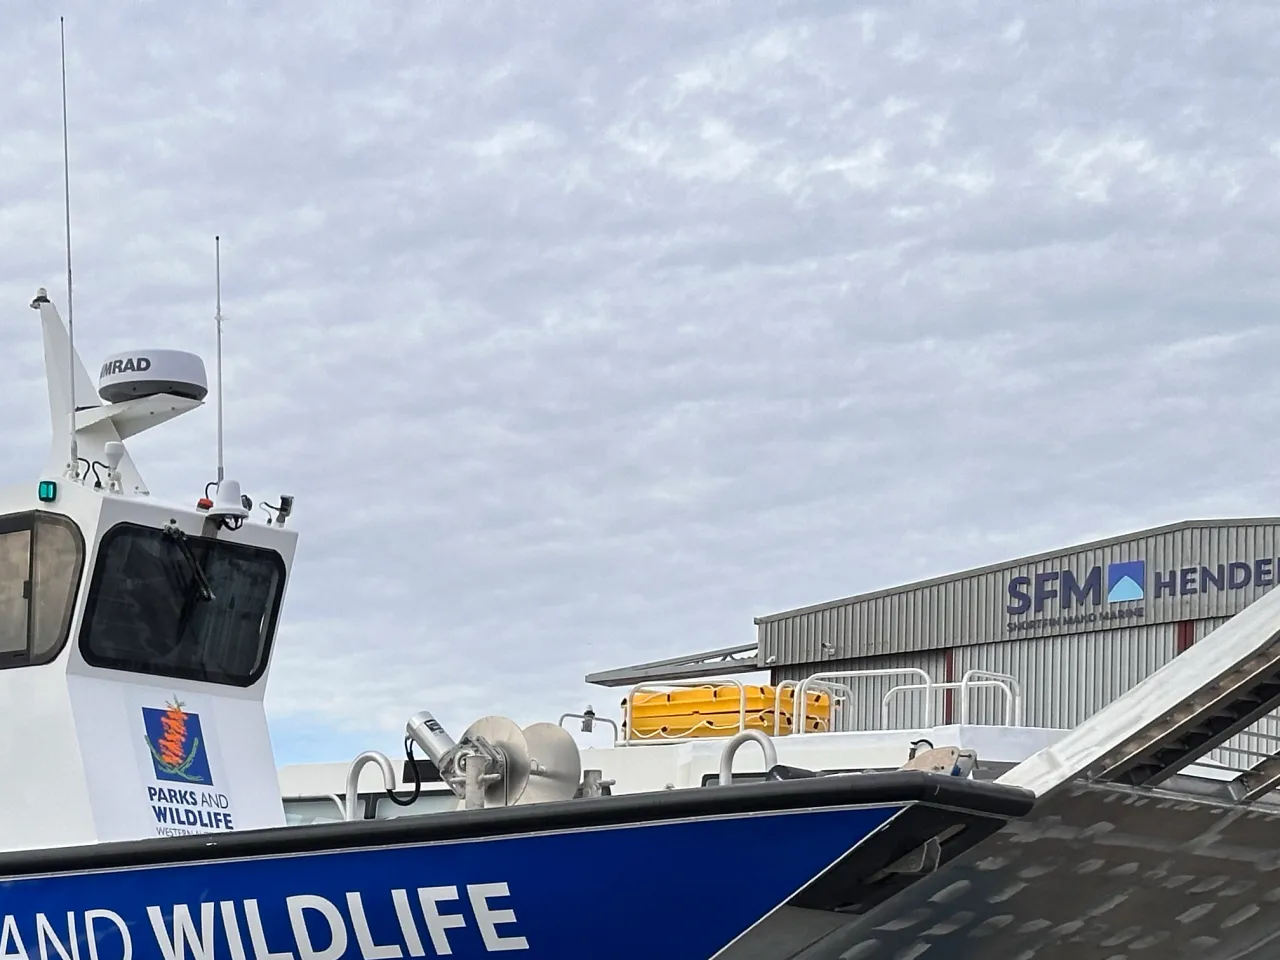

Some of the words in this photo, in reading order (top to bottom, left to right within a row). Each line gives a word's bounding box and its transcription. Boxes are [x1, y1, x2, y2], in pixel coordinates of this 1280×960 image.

[1007, 565, 1101, 615] SFM
[1154, 557, 1280, 598] HENDE
[1007, 616, 1060, 633] SHORTFIN
[1063, 612, 1097, 626] MAKO
[1100, 606, 1144, 621] MARINE
[147, 786, 198, 806] PARKS
[201, 792, 229, 809] AND
[151, 805, 234, 830] WILDLIFE
